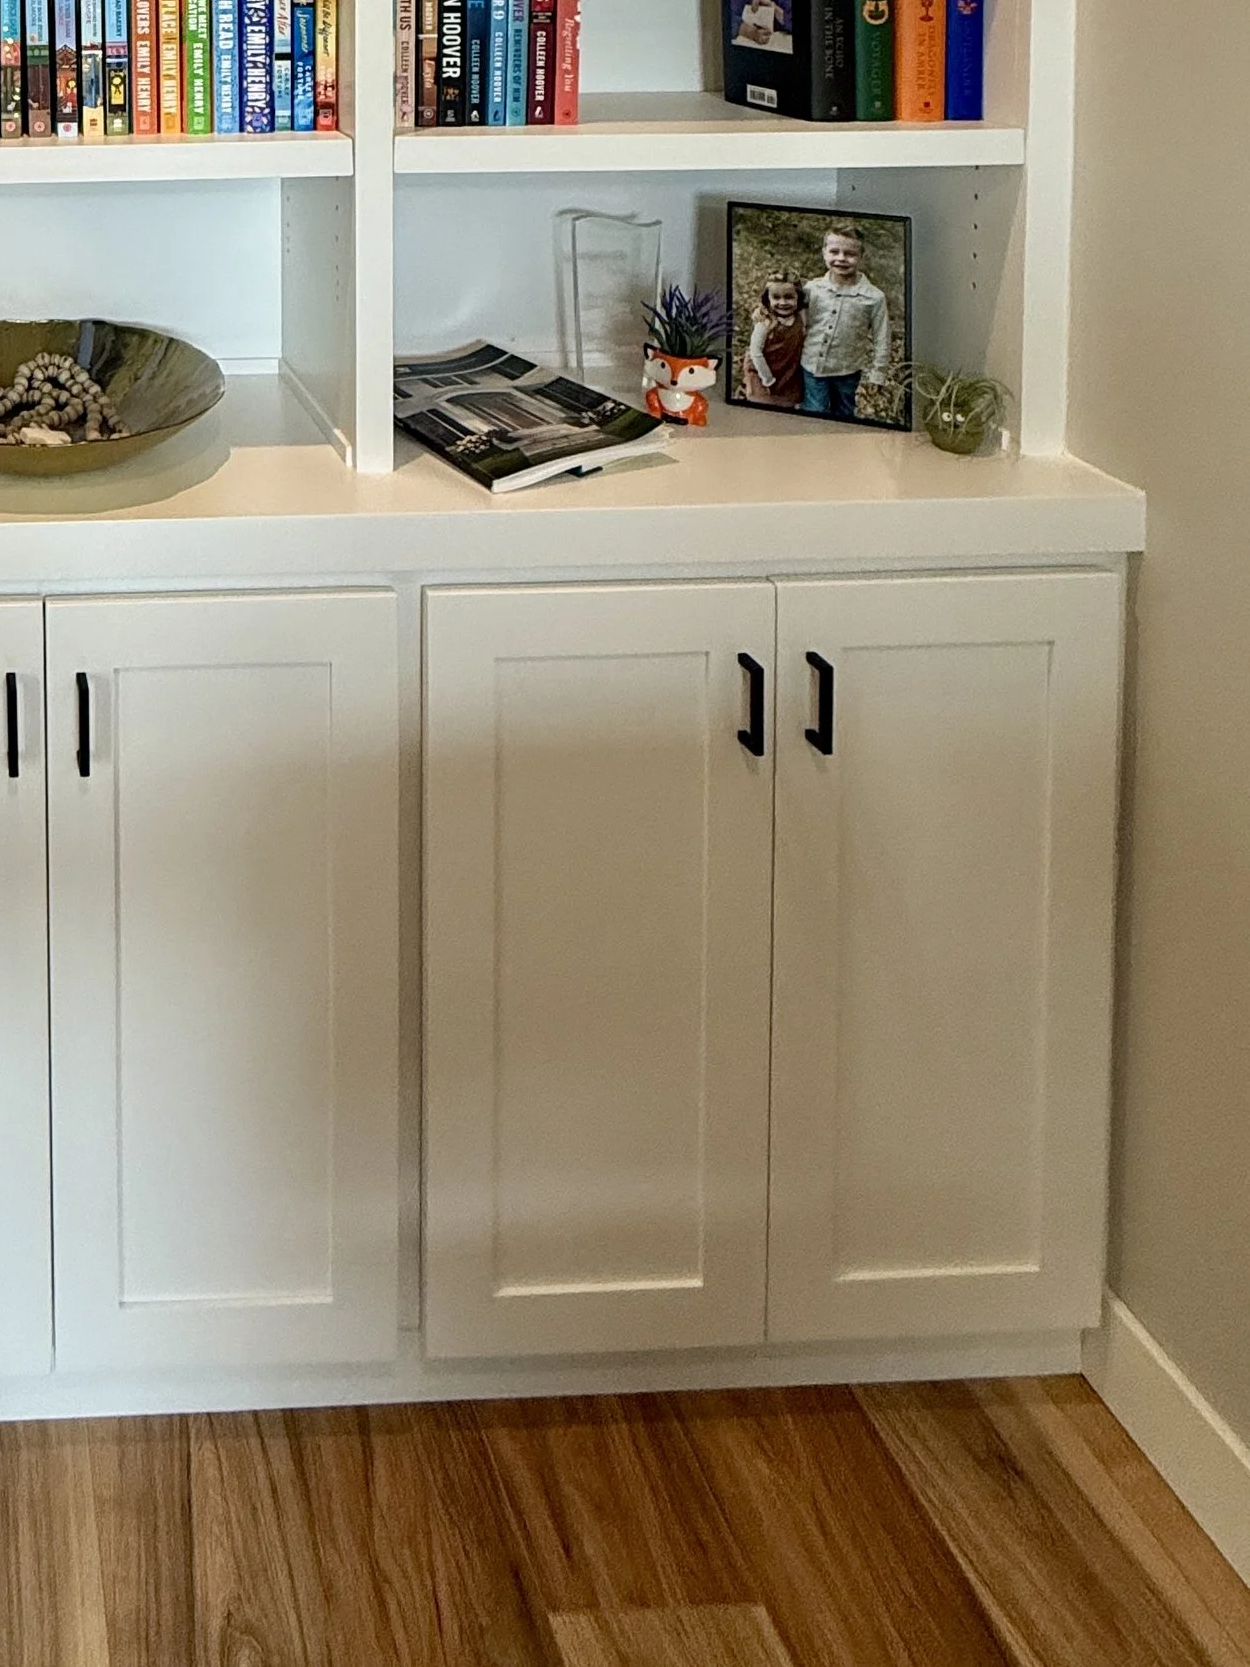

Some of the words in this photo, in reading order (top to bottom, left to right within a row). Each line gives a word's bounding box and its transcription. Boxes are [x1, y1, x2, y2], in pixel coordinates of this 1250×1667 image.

[219, 14, 233, 49] READ
[400, 17, 411, 30] US
[247, 26, 264, 65] EMILY
[442, 13, 461, 78] HOOVER
[247, 69, 265, 108] HENRY
